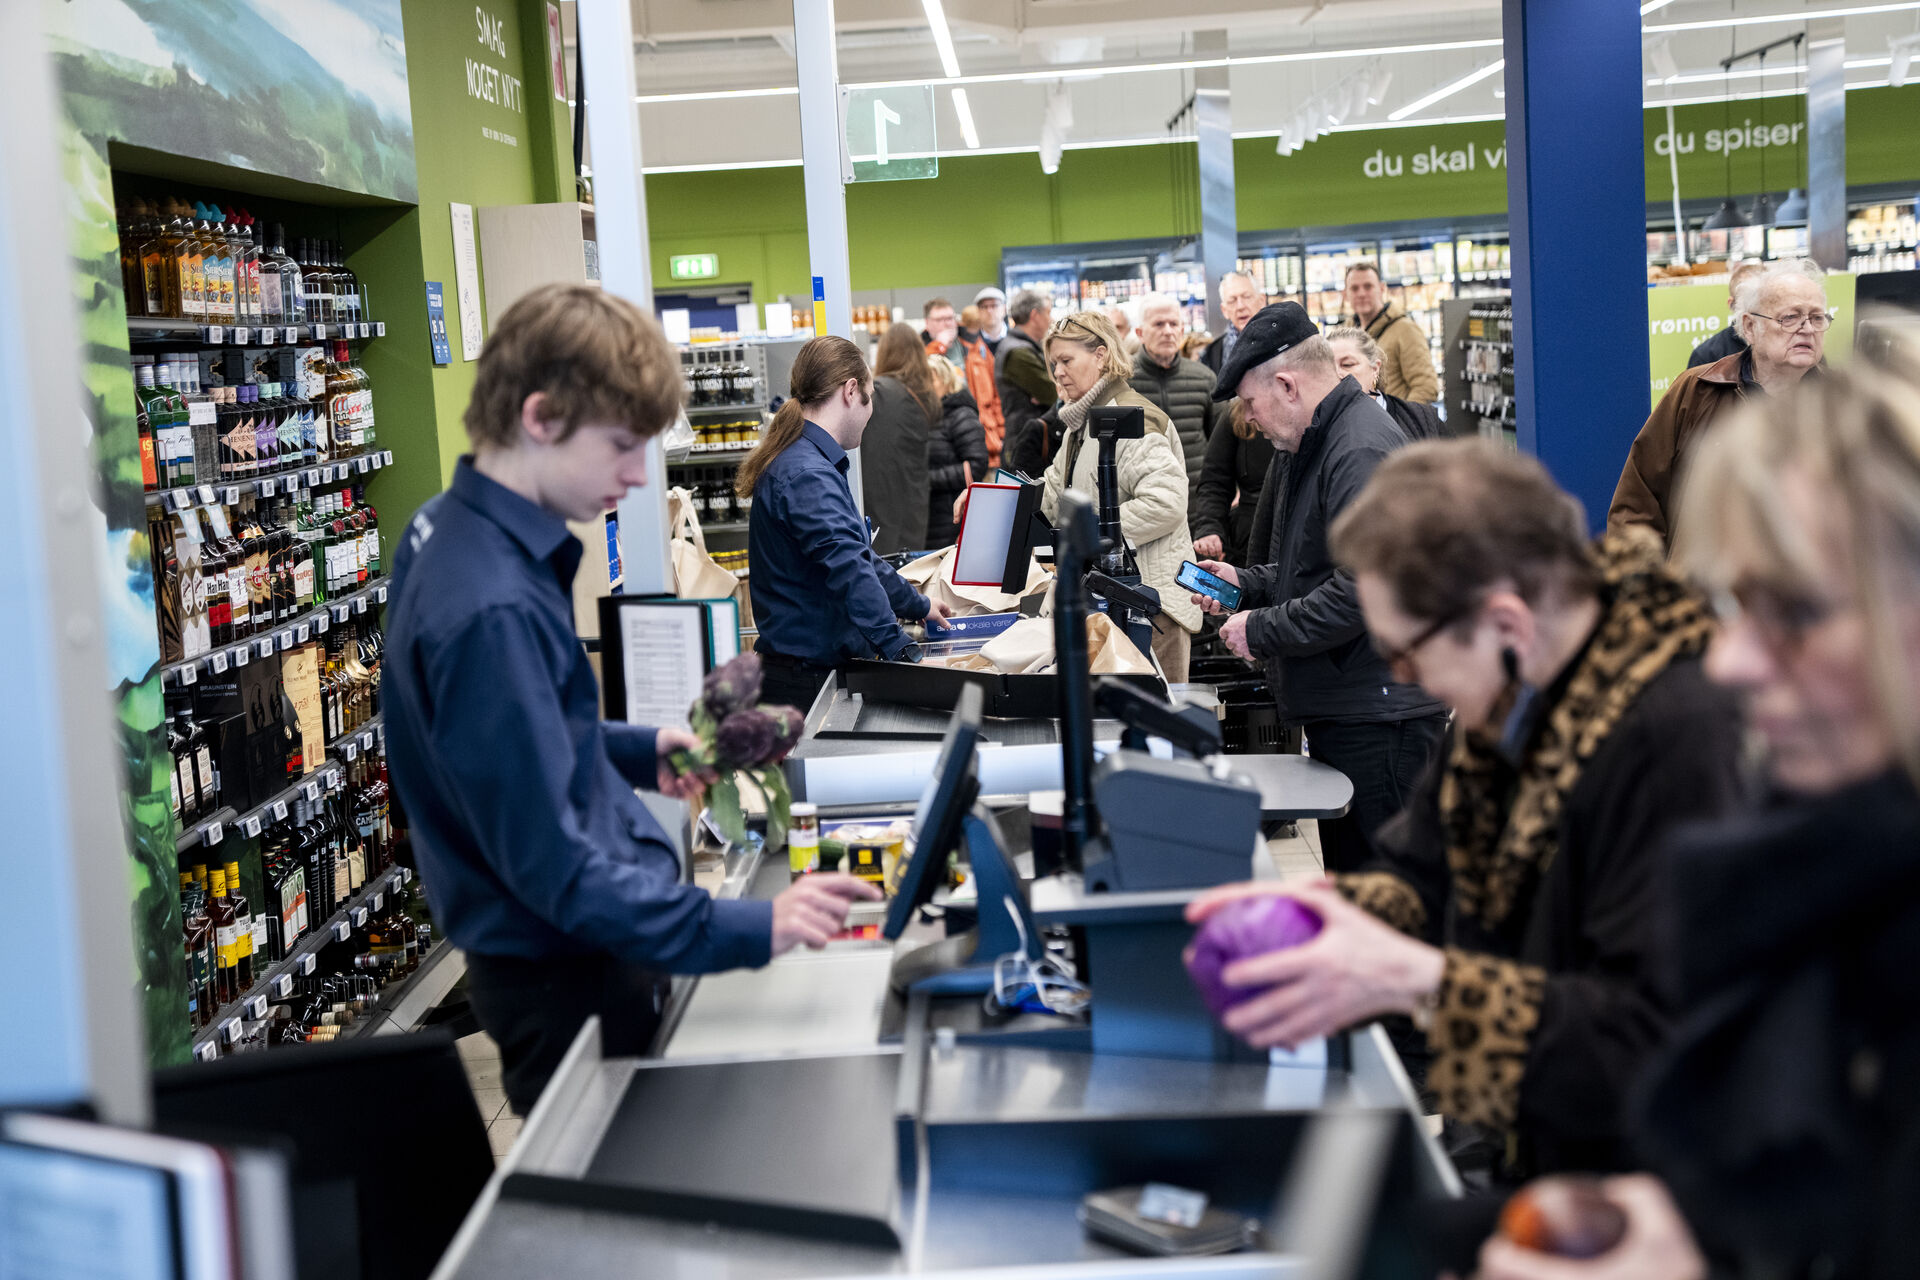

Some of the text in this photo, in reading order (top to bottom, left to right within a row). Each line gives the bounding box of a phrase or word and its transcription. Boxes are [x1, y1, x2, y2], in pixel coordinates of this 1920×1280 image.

[475, 5, 506, 59] SMAG
[465, 56, 521, 114] NOGET NYT
[1363, 149, 1403, 178] du
[1412, 142, 1475, 175] skal
[1653, 118, 1805, 157] du spiser
